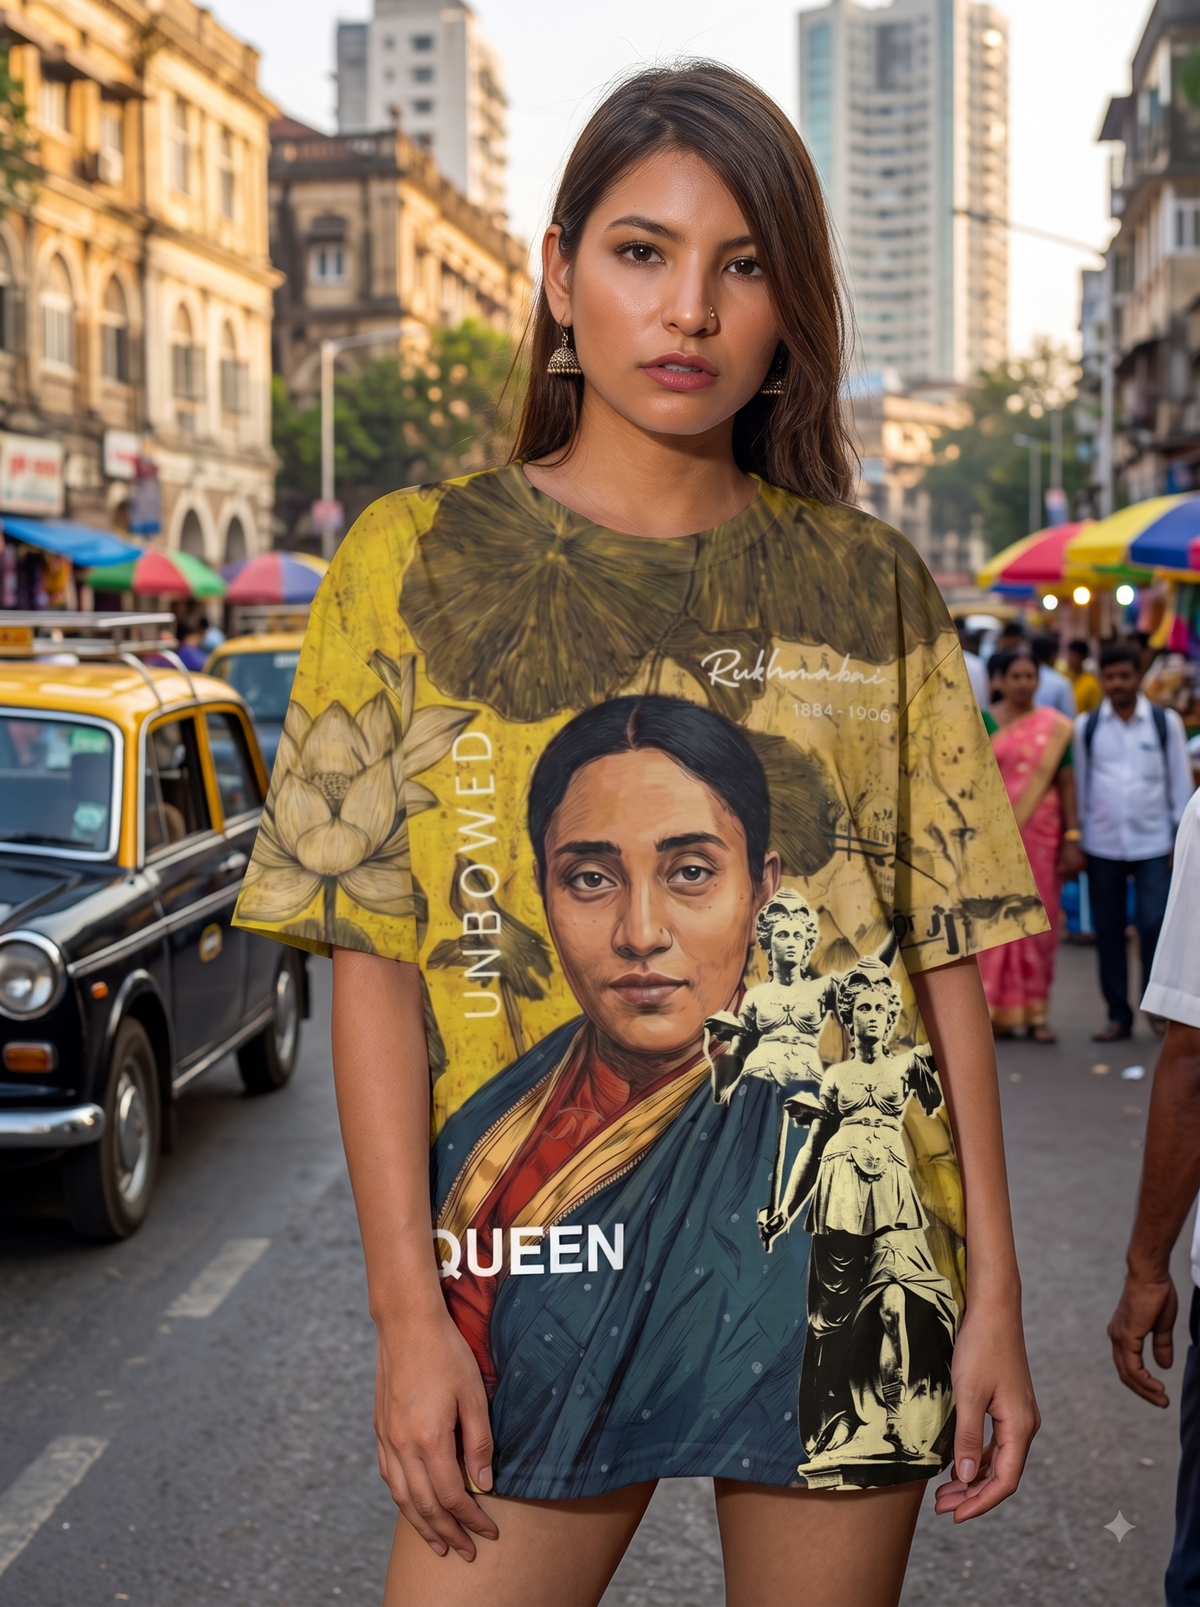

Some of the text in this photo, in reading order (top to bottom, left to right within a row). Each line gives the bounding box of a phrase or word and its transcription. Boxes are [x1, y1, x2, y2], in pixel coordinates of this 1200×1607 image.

[700, 647, 887, 688] Rukhmabai
[793, 703, 833, 717] 1884
[849, 705, 892, 723] 1906
[451, 731, 502, 1019] UNBOWED
[431, 1223, 625, 1281] QUEEN
